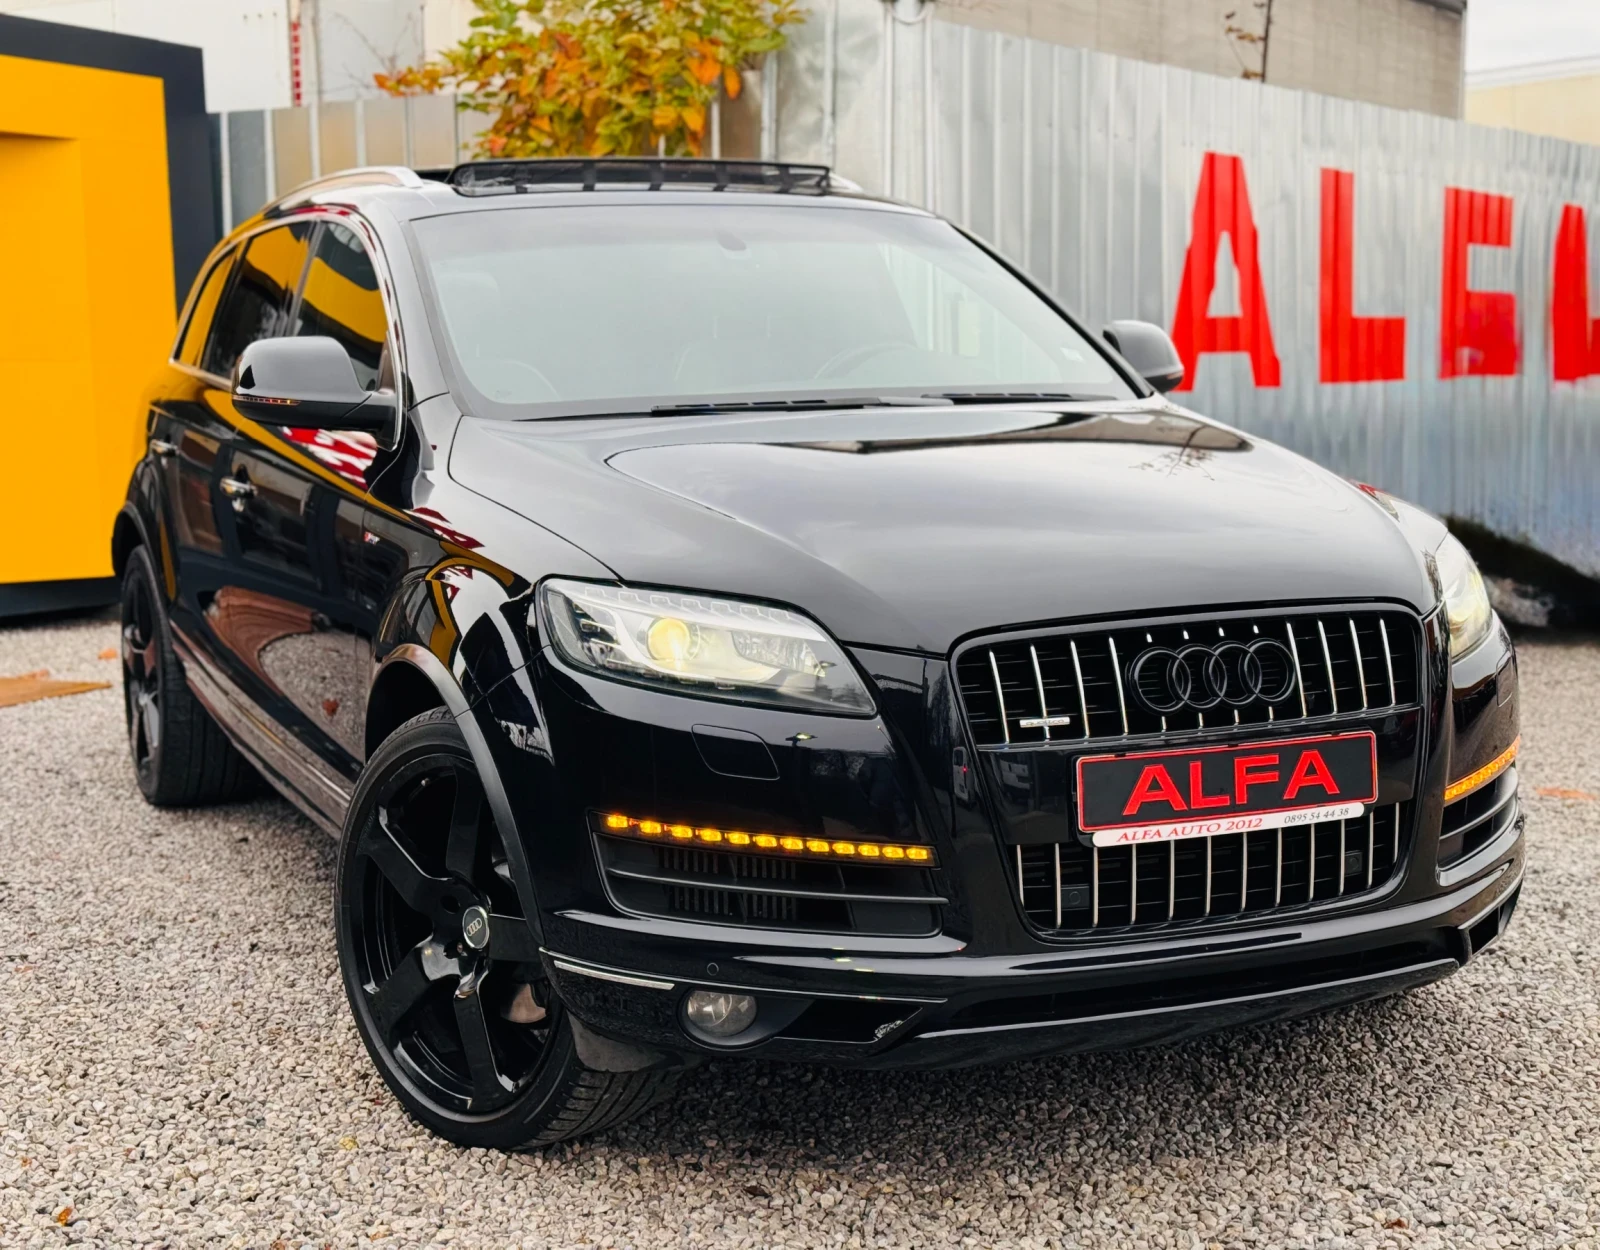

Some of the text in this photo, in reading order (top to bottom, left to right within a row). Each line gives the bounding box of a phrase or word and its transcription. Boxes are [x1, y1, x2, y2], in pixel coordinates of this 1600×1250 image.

[1122, 749, 1341, 816] ALFA
[1116, 828, 1162, 842] ALFA
[1166, 822, 1221, 837] AUTO
[1224, 817, 1262, 832] 2012
[1283, 813, 1307, 824] 0895
[1338, 807, 1349, 816] 38
